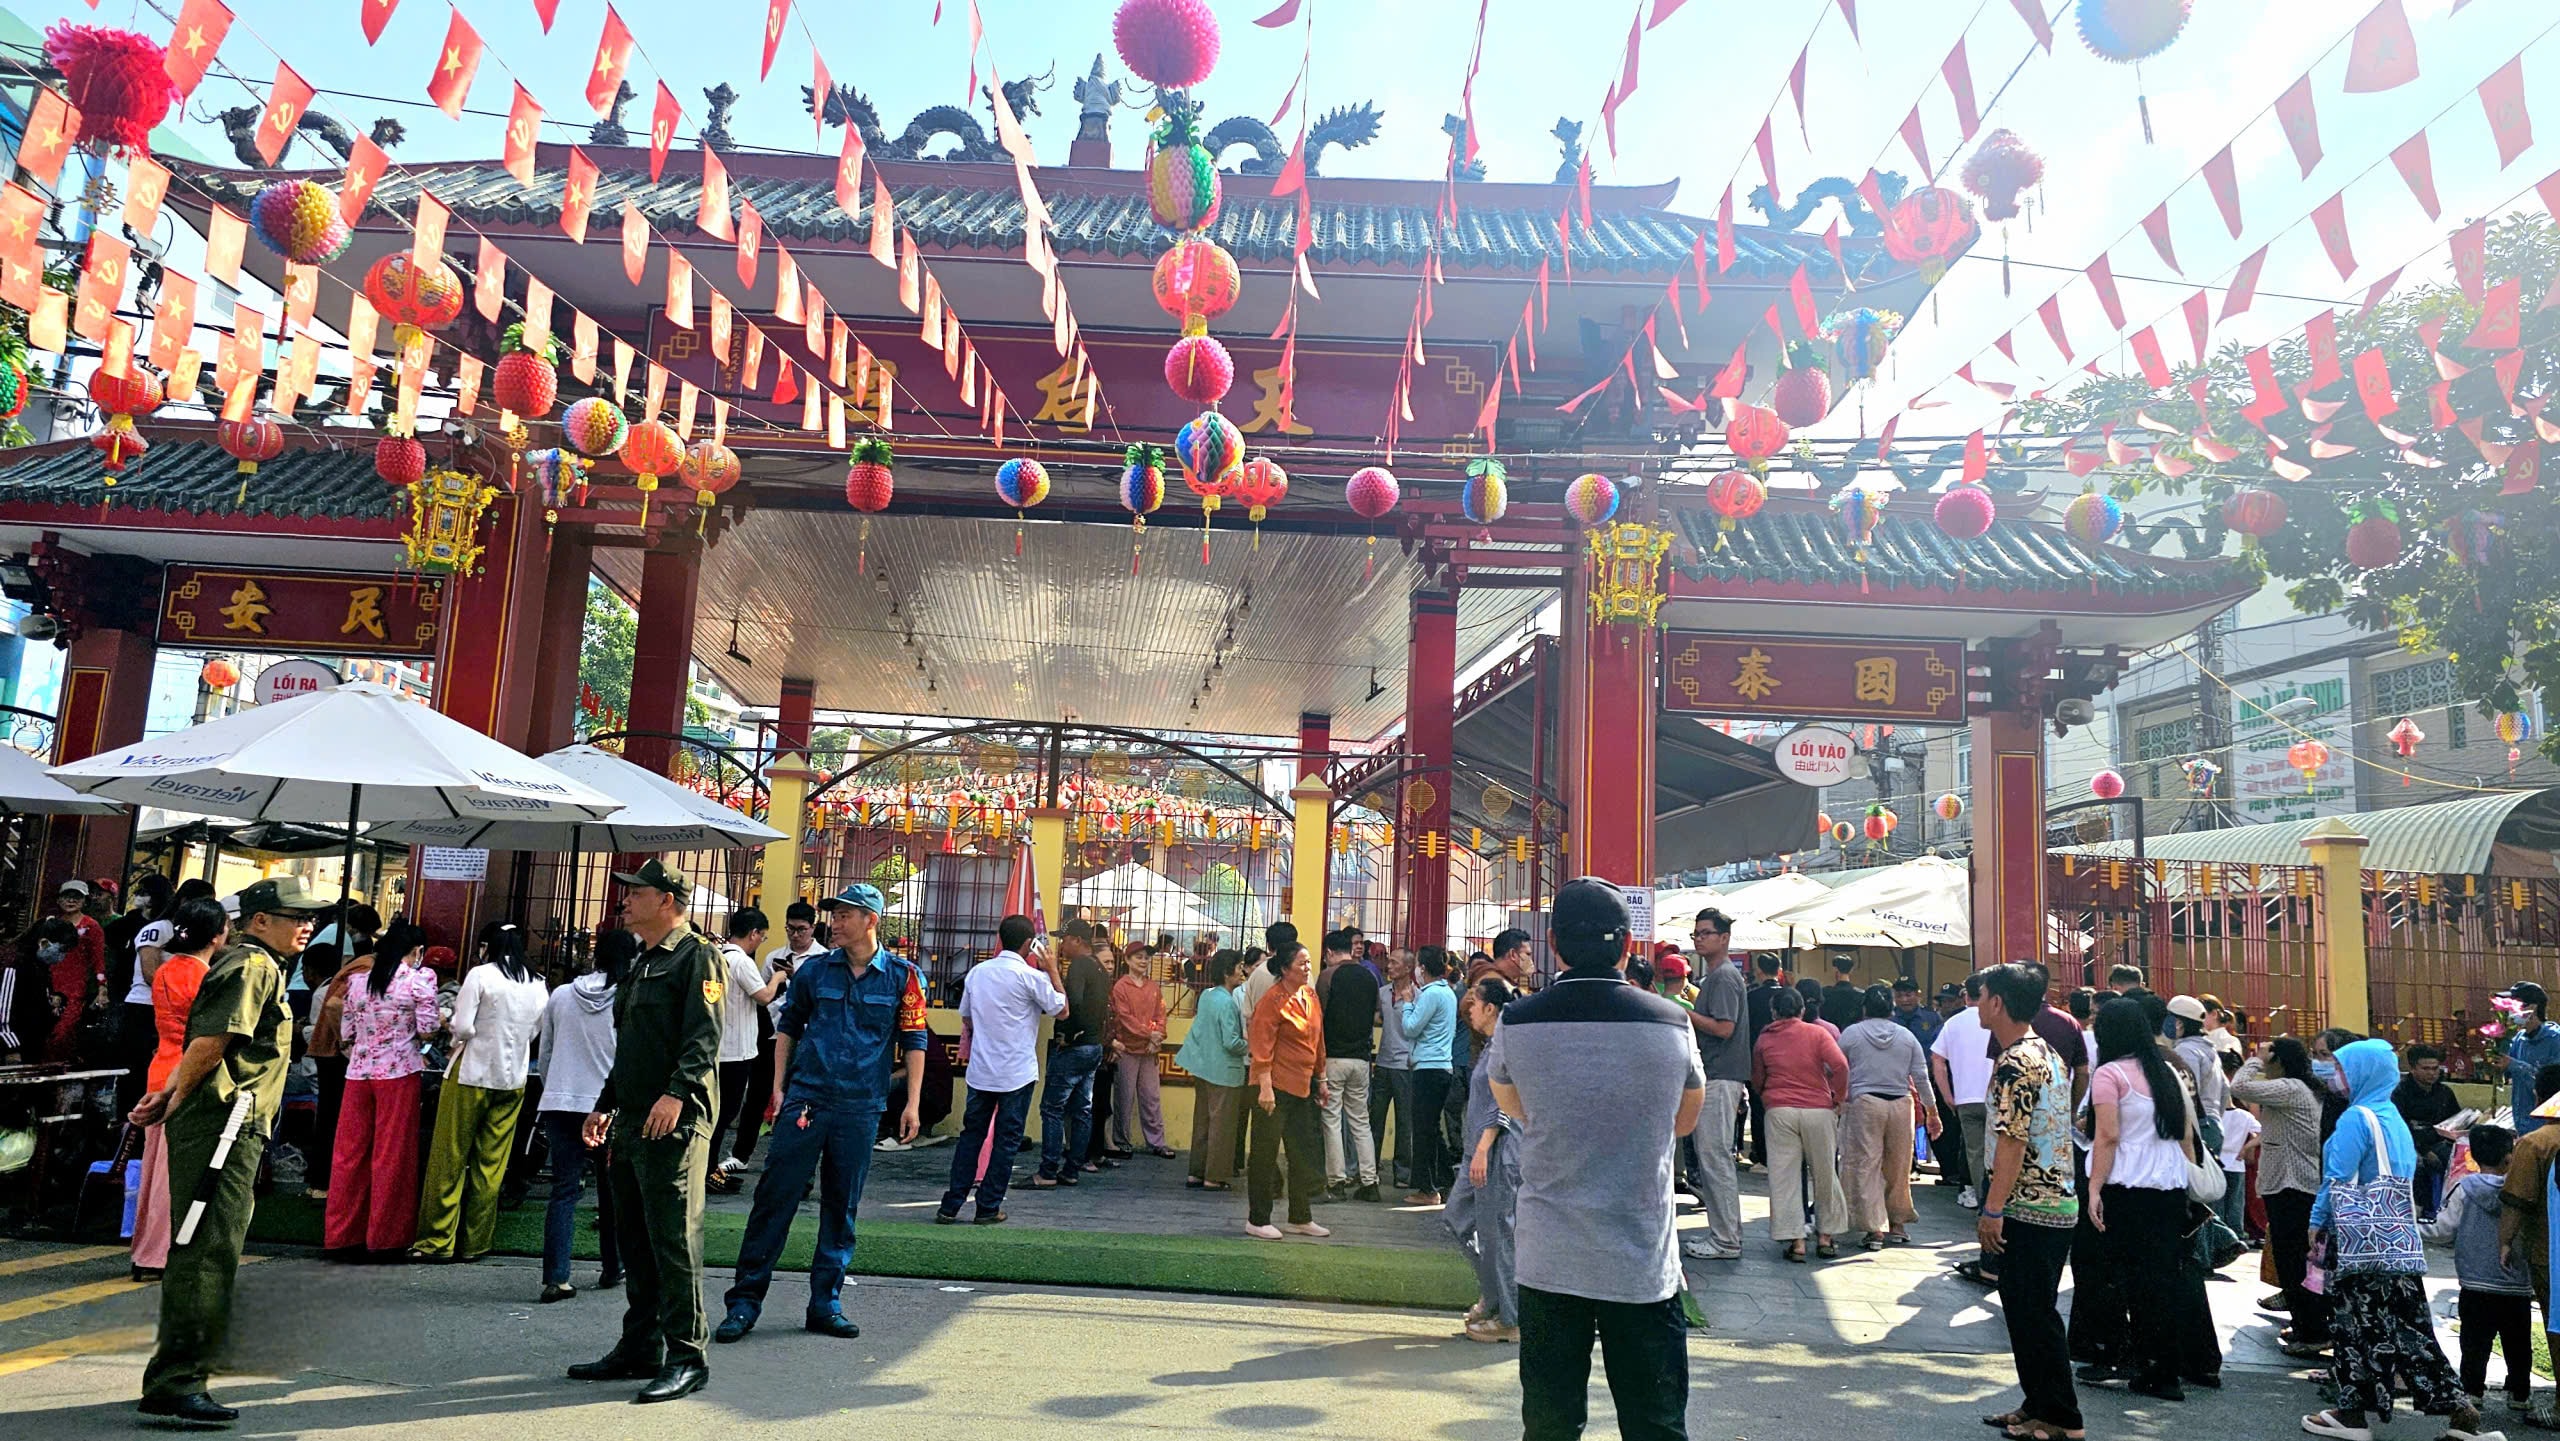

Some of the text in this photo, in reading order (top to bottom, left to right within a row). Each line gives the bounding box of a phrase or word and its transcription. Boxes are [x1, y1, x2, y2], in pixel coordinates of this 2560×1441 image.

[273, 672, 318, 691] LỐI RA
[1791, 739, 1847, 759] LỐI VÀO
[1794, 761, 1841, 773] 由此門入
[140, 928, 160, 943] 90
